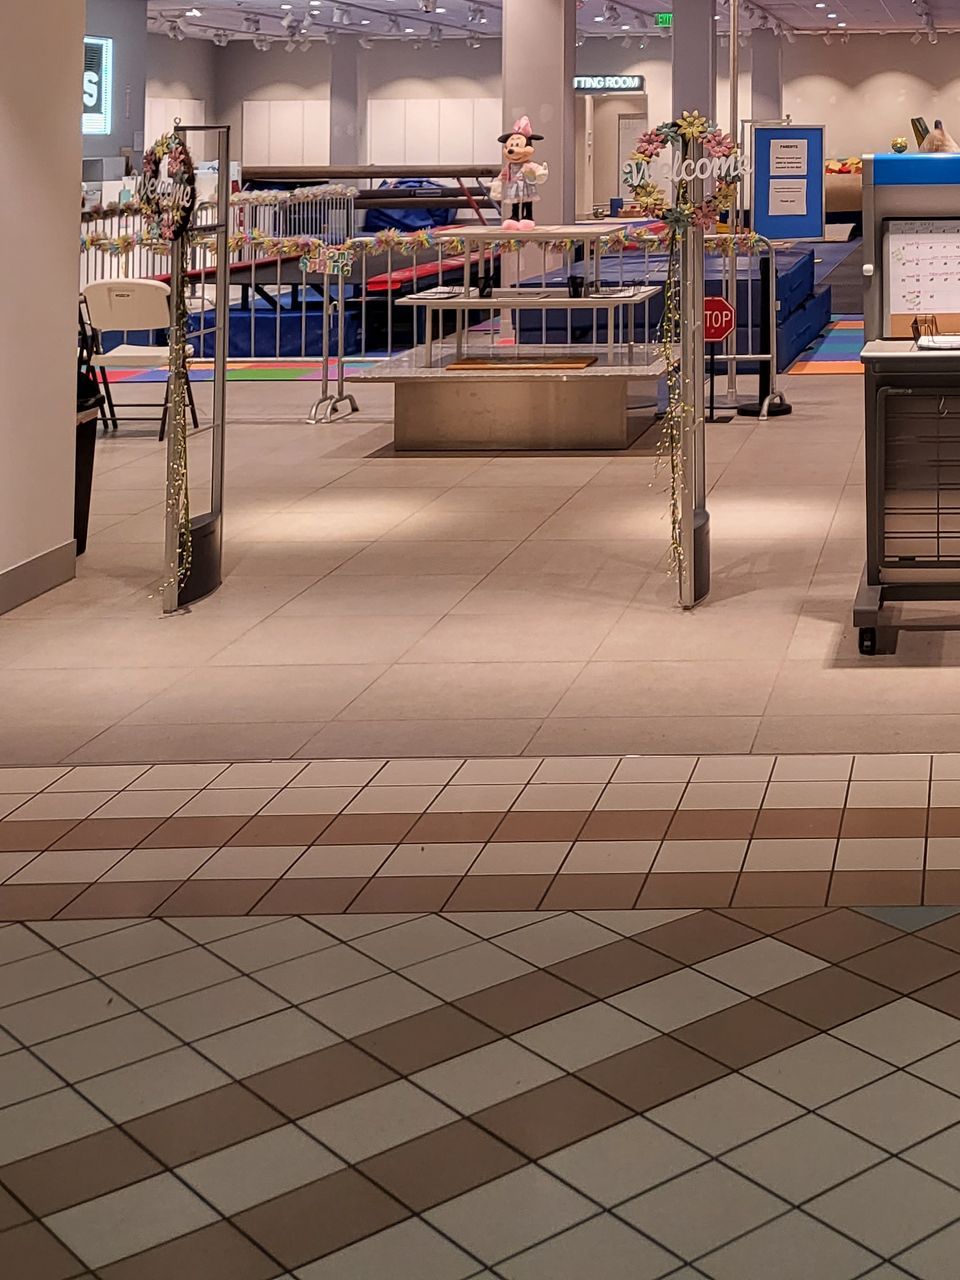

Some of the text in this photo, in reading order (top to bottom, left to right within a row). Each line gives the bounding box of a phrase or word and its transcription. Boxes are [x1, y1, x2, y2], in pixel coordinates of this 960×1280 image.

[574, 76, 639, 88] TTING ROOM
[622, 150, 753, 187] Welcome
[131, 169, 193, 208] Welcome
[704, 311, 731, 327] TOP
